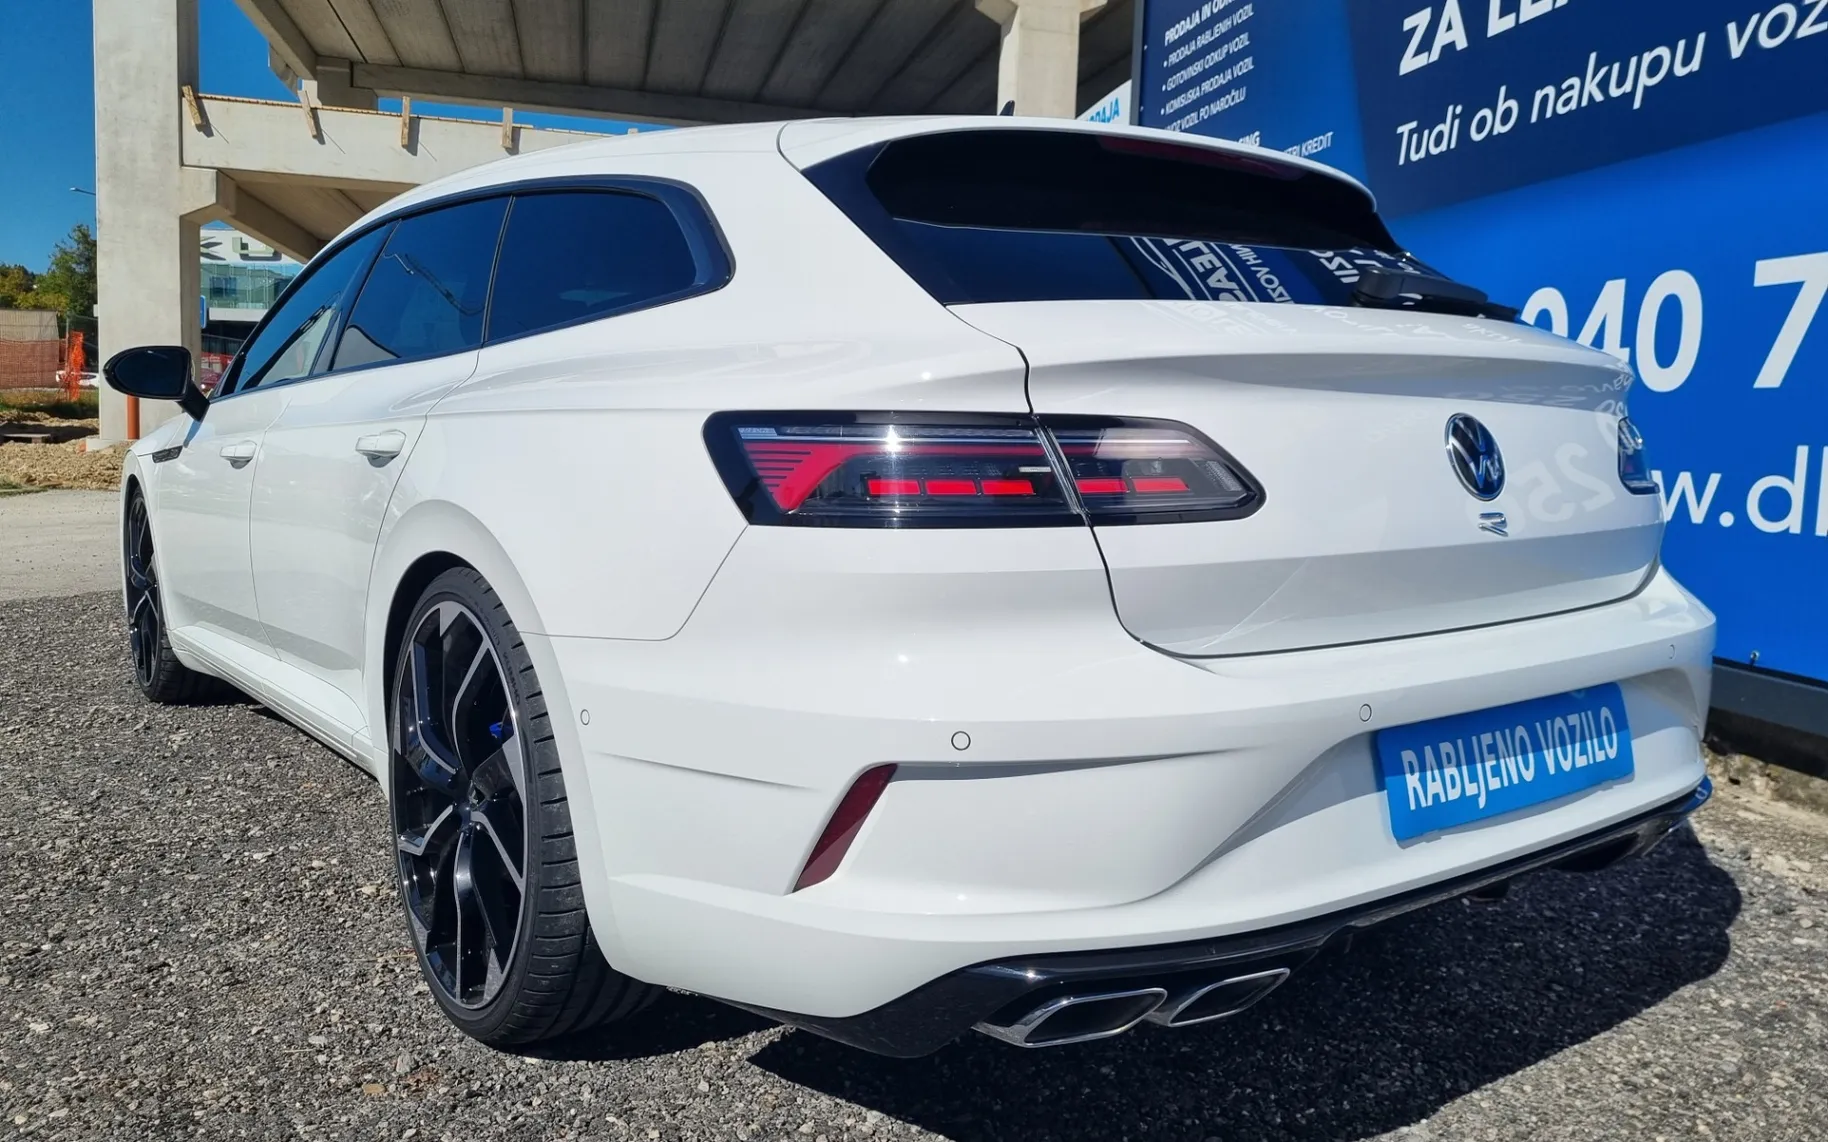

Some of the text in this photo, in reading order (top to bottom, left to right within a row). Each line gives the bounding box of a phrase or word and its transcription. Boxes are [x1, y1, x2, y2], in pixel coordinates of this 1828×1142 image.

[1164, 10, 1201, 47] PRODAJA
[1201, 1, 1212, 22] IN
[1168, 3, 1254, 68] PRODAJA RABLJENIH VOZIL
[1399, 0, 1468, 76] ZA
[1166, 31, 1250, 91] GOTOVINSKI ODKUP VOZIL
[1200, 68, 1233, 96] PRODAJA
[1232, 56, 1254, 79] VOZIL
[1180, 111, 1200, 130] VOZIL
[1199, 105, 1210, 121] PO
[1209, 86, 1247, 116] NAROČILU
[1396, 105, 1463, 166] Tudi
[1470, 85, 1519, 142] ob
[1530, 32, 1706, 123] nakupu
[1301, 131, 1334, 157] KREDIT
[1753, 251, 1828, 389] 7
[1400, 706, 1618, 810] RABLJENO VOZILO
